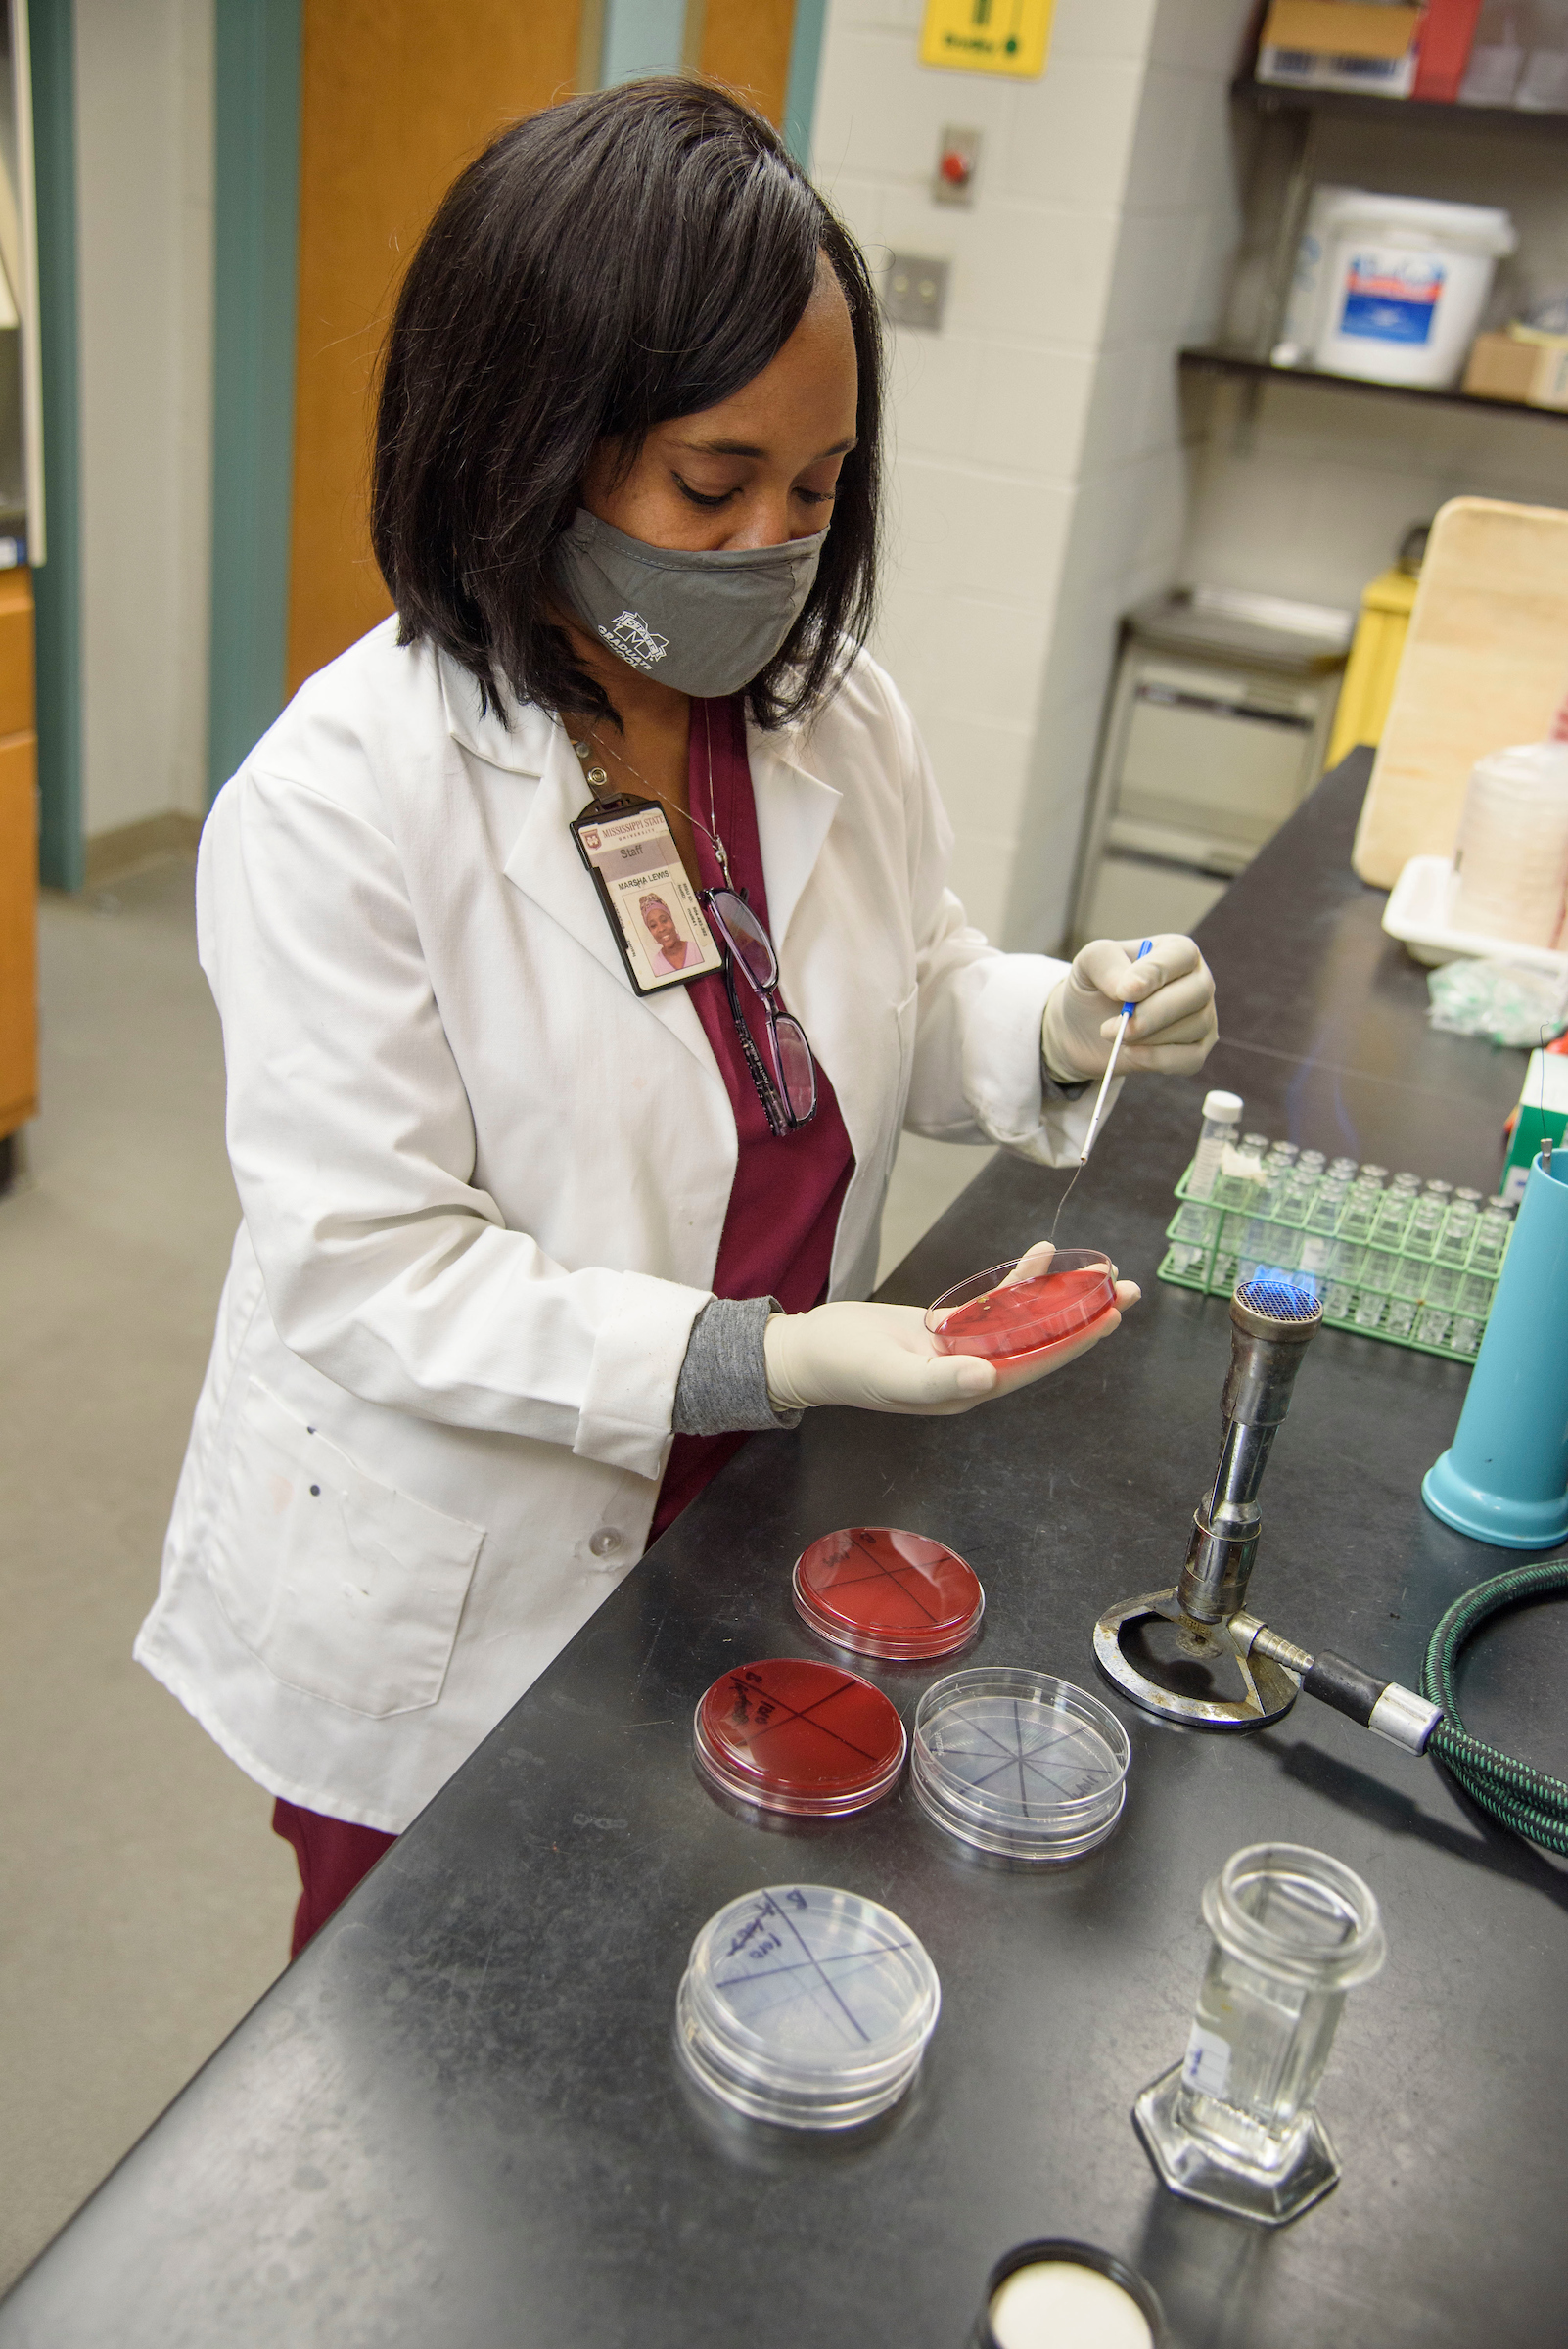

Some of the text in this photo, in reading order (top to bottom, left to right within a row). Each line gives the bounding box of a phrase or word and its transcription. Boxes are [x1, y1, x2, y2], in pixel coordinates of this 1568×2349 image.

[597, 624, 654, 670] GRADUATE
[626, 619, 660, 654] STATE
[602, 814, 666, 839] MISSISSIPPI STATE
[618, 828, 655, 841] UNIVERSITY
[620, 844, 644, 859] Staff
[618, 870, 669, 891] MARSHA LEWIS
